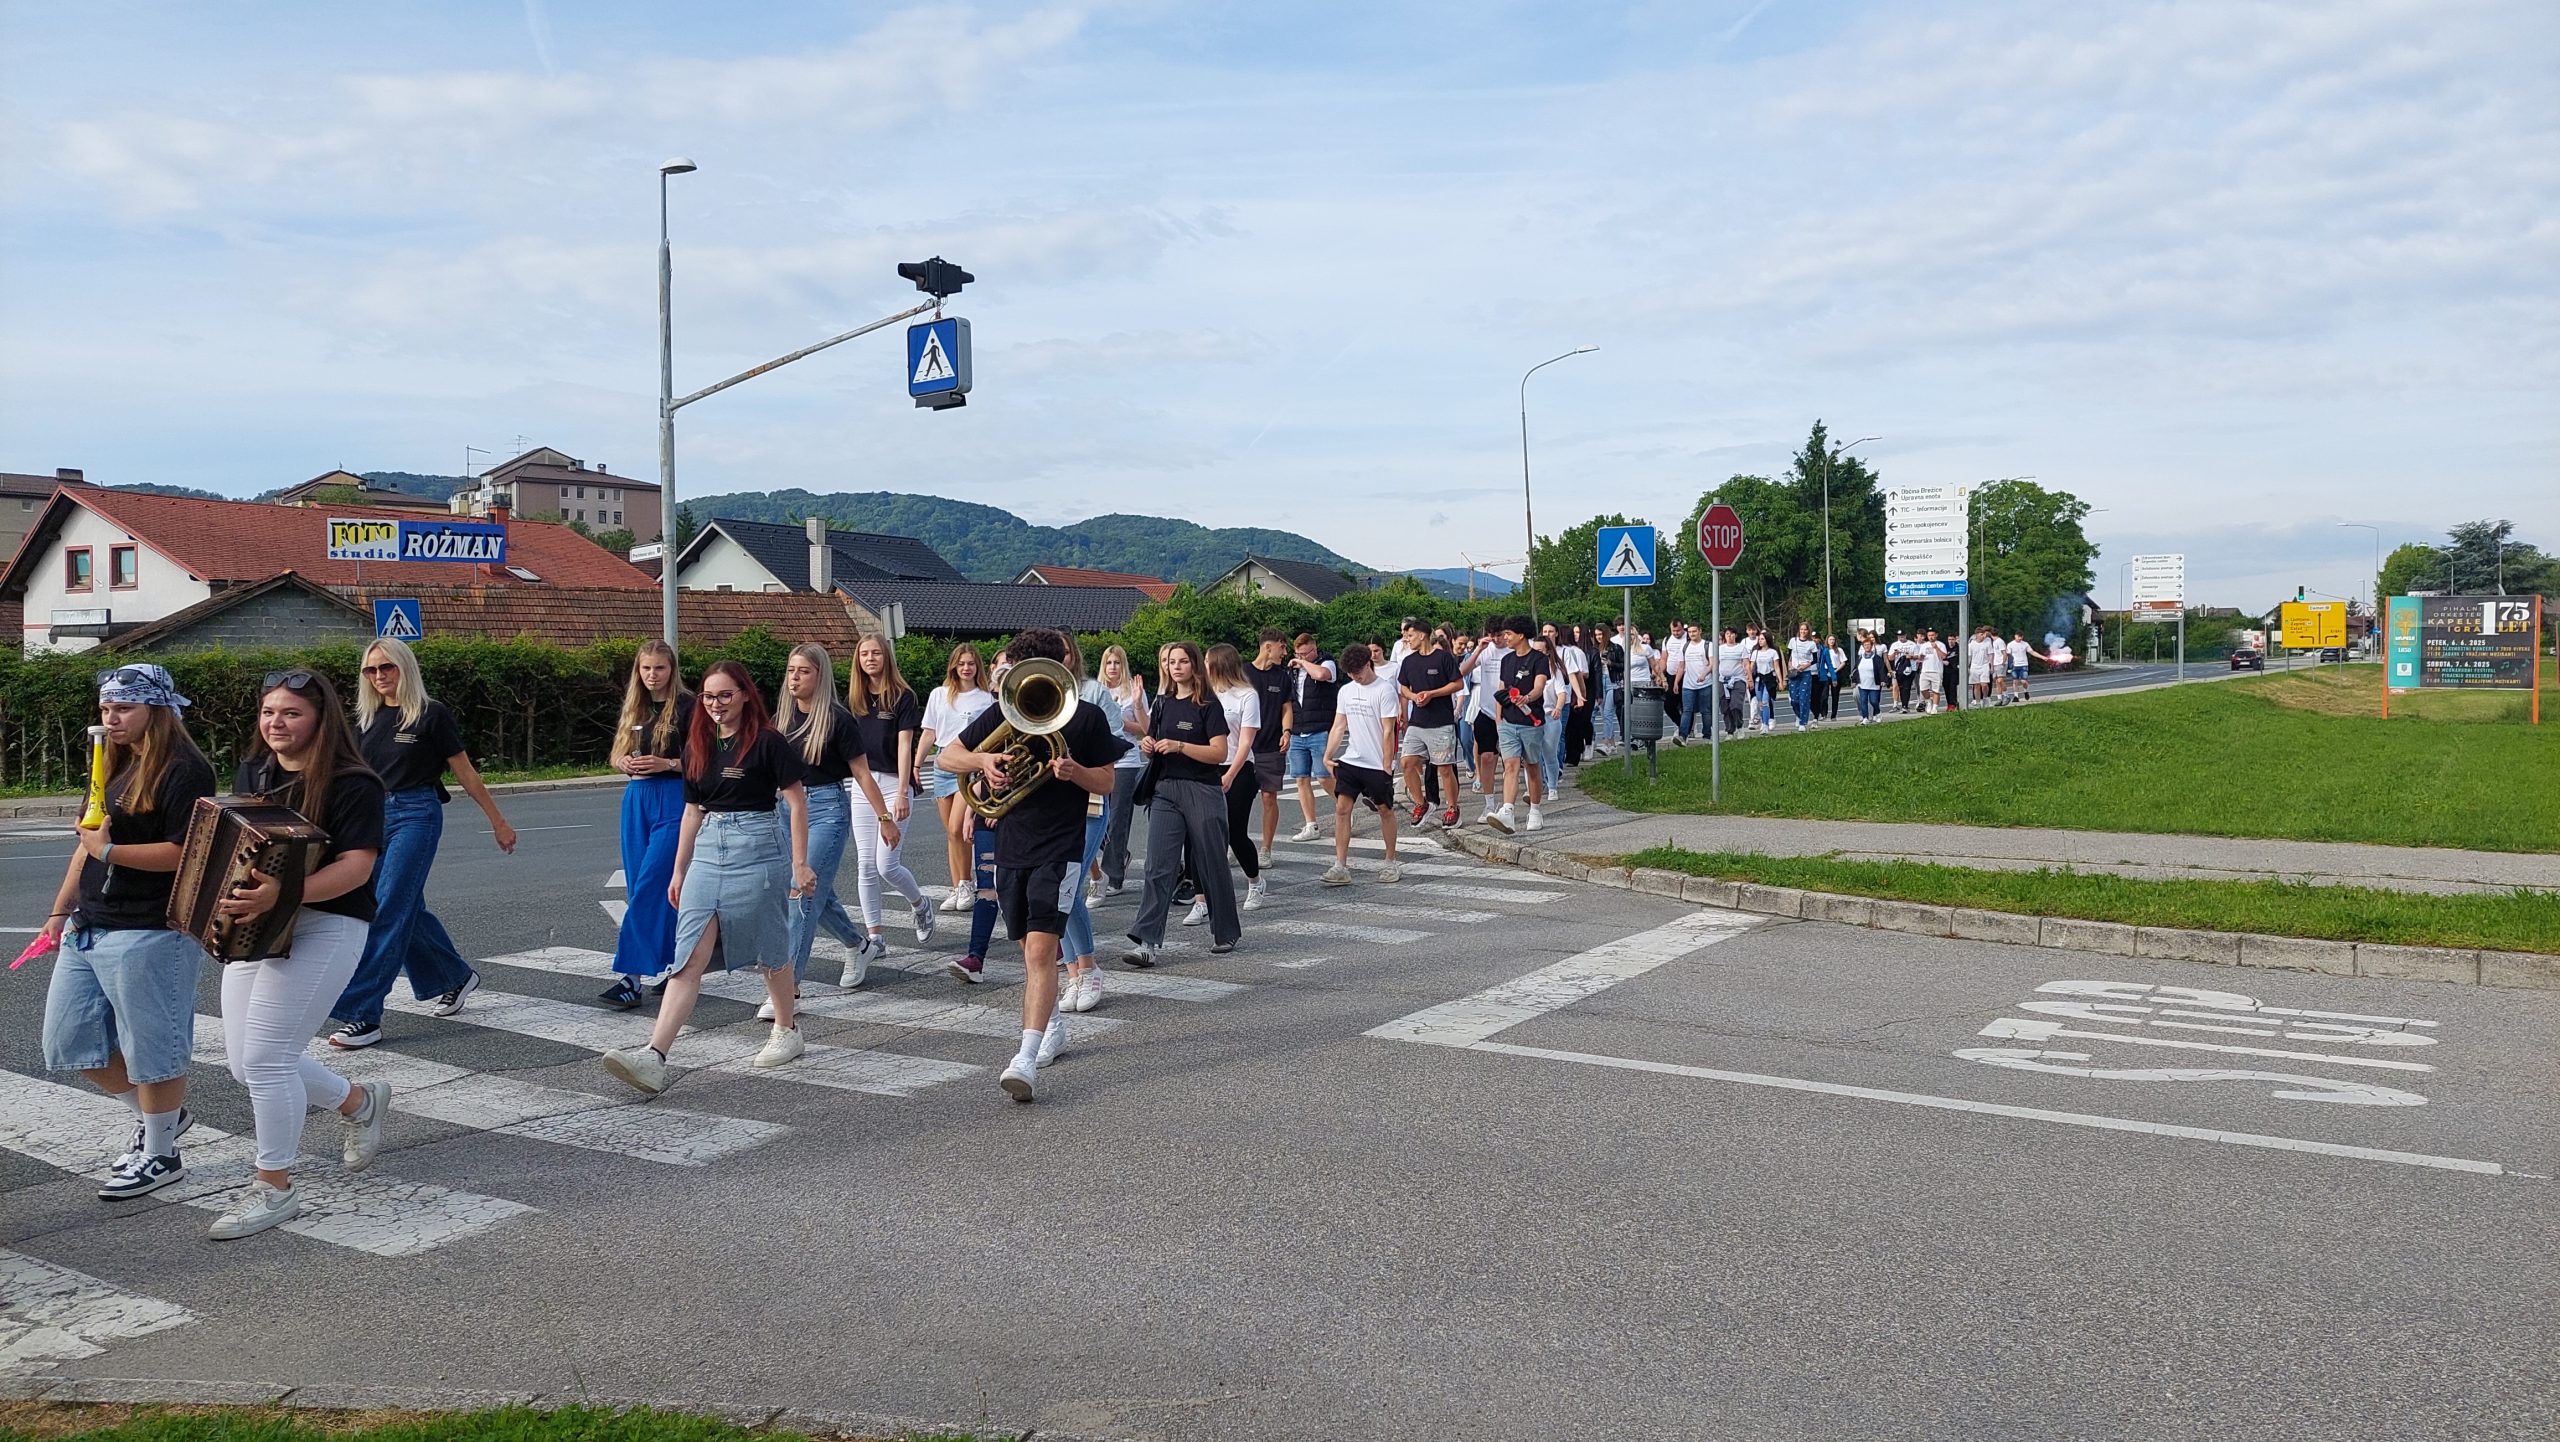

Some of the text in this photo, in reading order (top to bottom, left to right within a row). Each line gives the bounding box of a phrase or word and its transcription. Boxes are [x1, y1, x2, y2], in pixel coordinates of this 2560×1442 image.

[330, 521, 396, 549] FOTO
[404, 528, 503, 559] ROŽMAN
[1703, 524, 1739, 549] STOP
[330, 548, 397, 559] studio
[2447, 625, 2481, 633] IGRA
[2498, 620, 2531, 633] LET
[1952, 980, 2438, 1107] STOP
